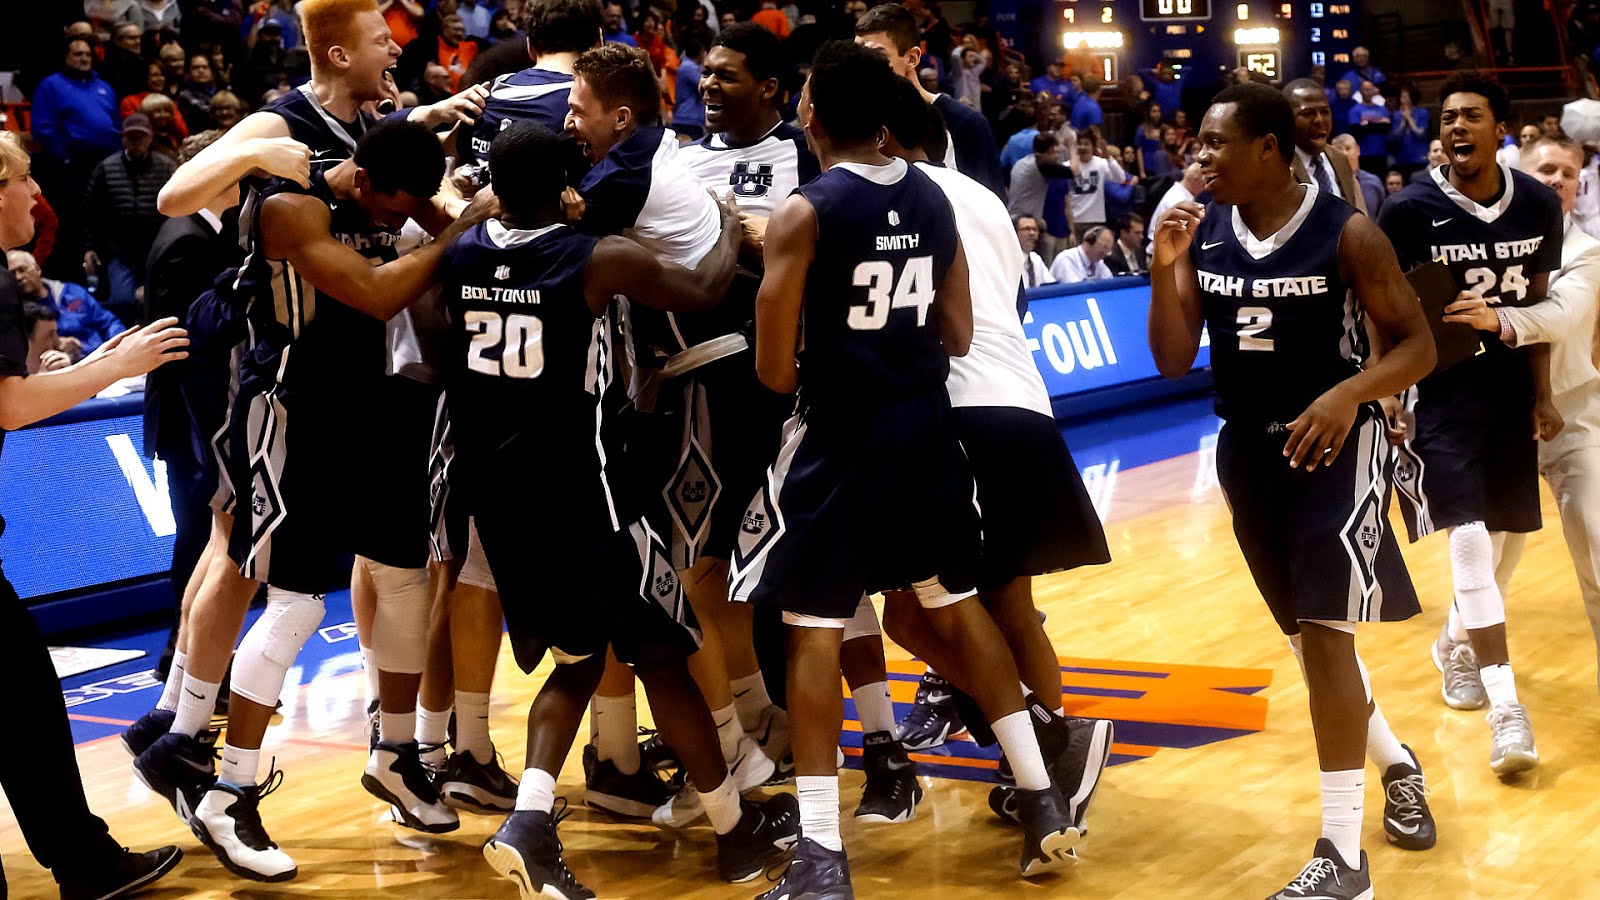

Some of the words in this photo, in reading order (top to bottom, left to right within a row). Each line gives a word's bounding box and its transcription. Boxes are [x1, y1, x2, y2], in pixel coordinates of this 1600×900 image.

[876, 233, 920, 251] SMITH
[461, 285, 526, 304] BOLTON
[526, 289, 541, 304] III
[847, 255, 937, 331] 34
[1252, 276, 1329, 298] STATE
[1464, 264, 1530, 304] 24
[464, 310, 545, 379] 20
[1236, 306, 1275, 352] 2
